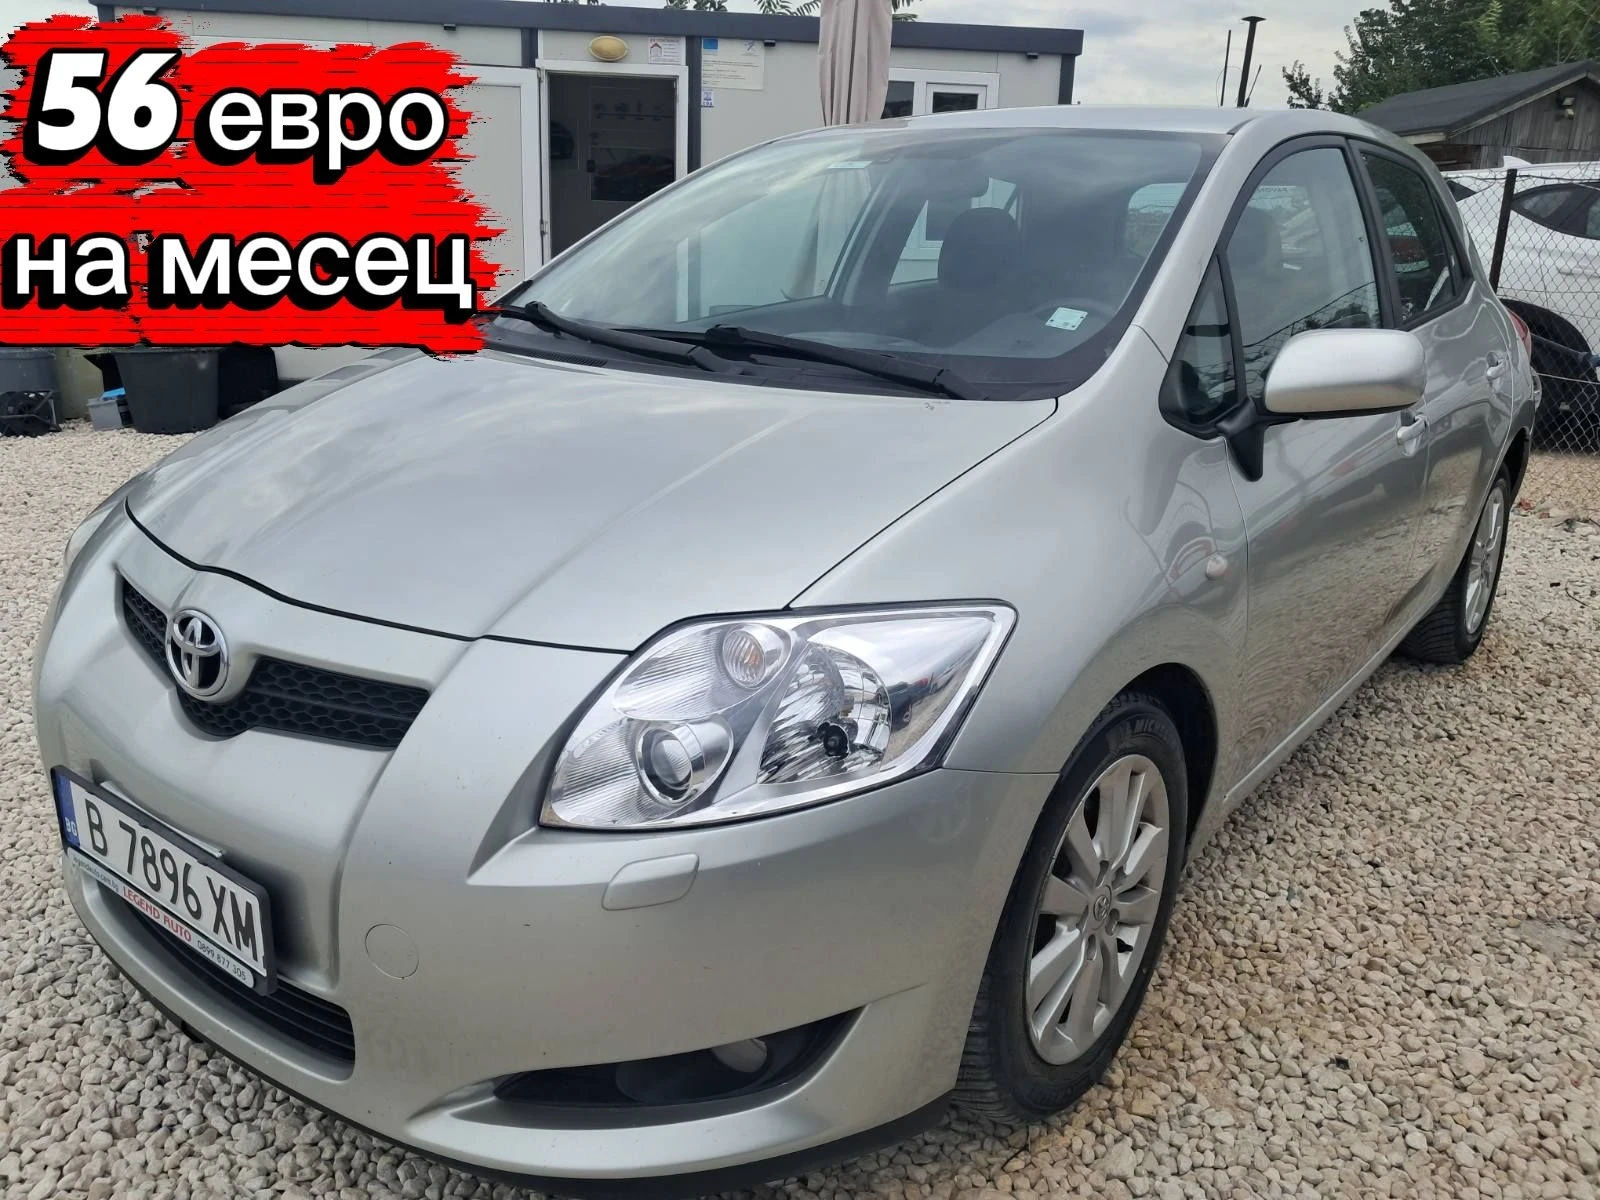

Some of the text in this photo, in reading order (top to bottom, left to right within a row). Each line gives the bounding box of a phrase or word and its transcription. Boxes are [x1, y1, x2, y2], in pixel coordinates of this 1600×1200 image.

[64, 816, 78, 837] BG
[118, 819, 202, 921] 7896
[123, 885, 161, 920] LEGEND
[163, 914, 193, 943] AUTO
[197, 939, 215, 959] 0899
